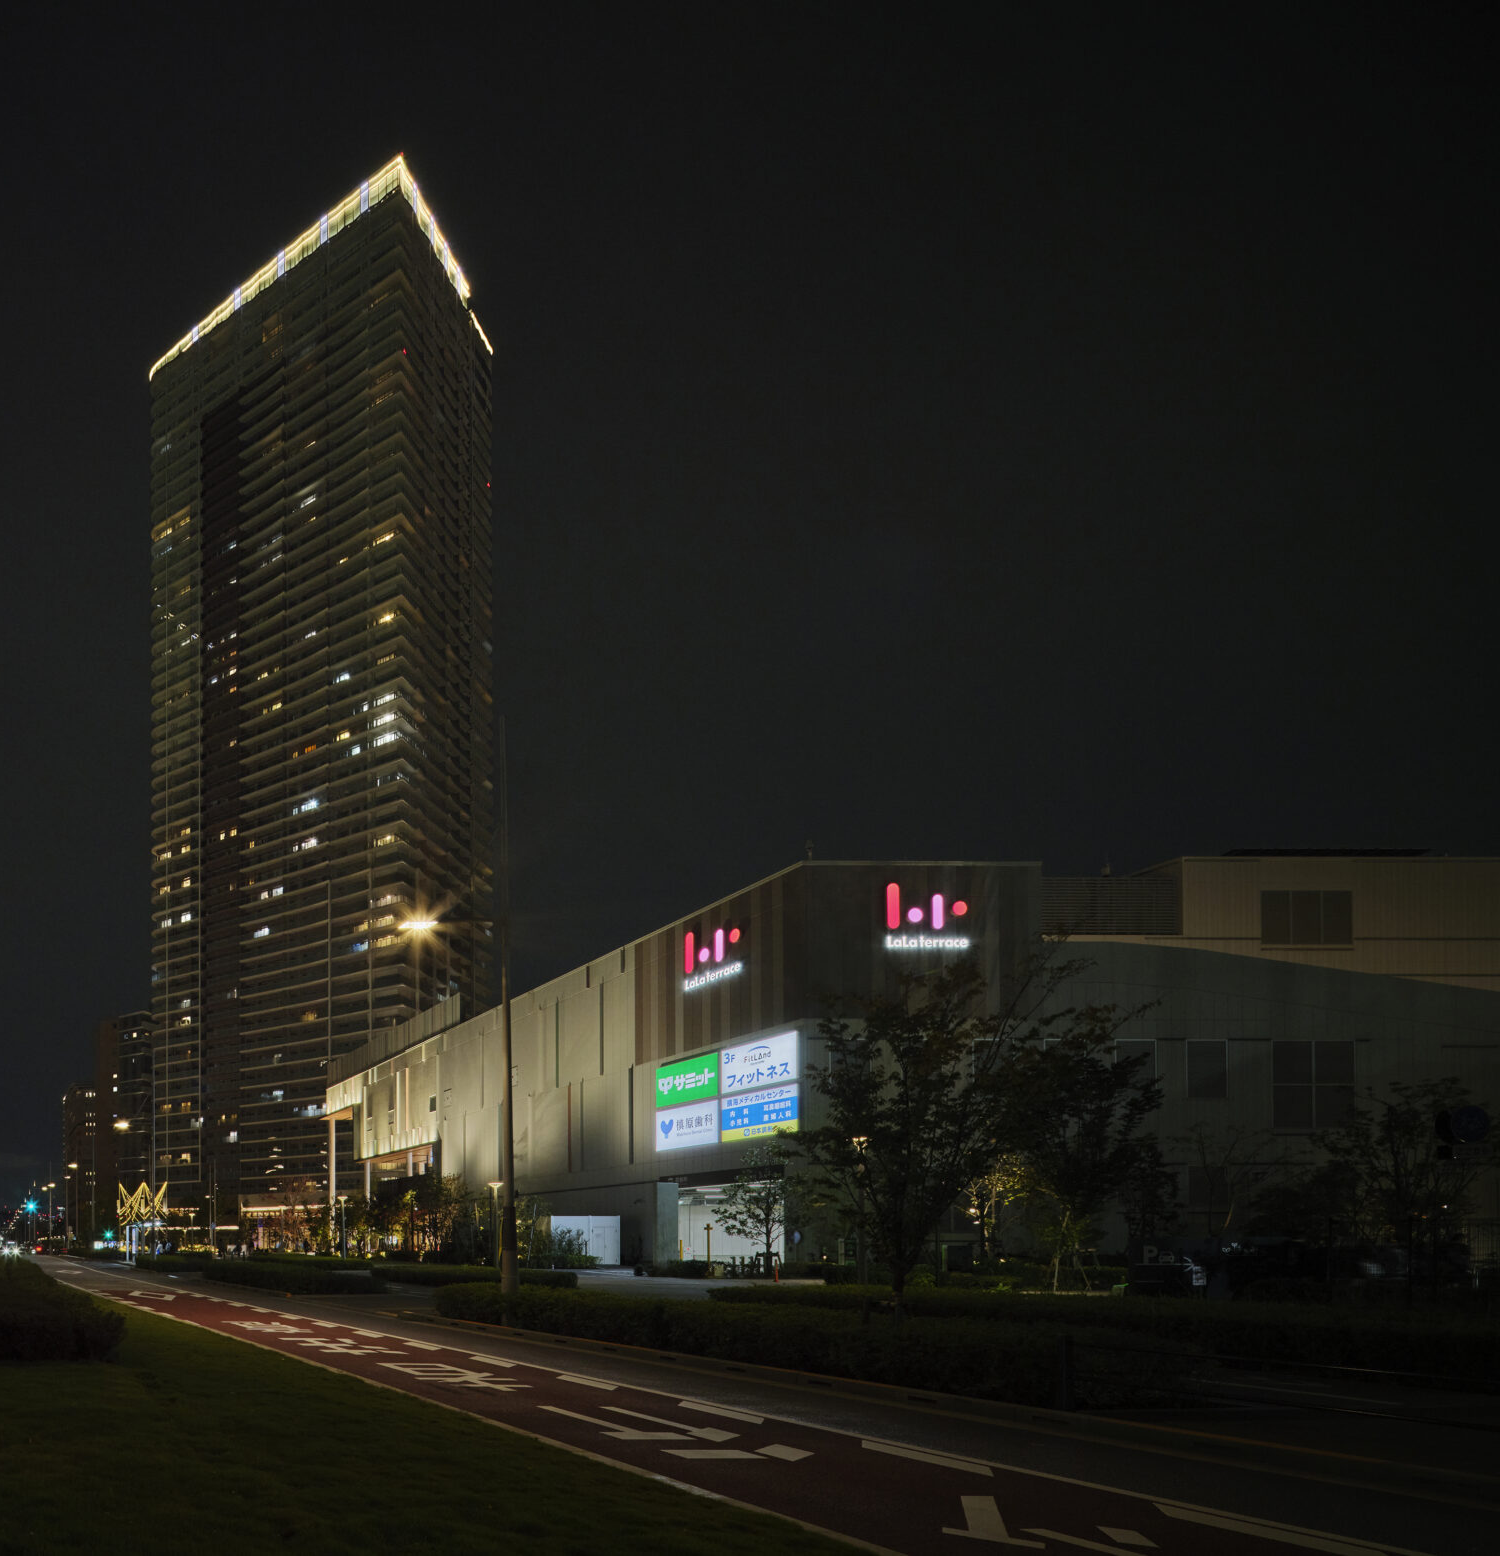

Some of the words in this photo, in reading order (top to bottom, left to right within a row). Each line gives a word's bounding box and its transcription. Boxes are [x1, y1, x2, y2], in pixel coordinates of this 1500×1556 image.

[724, 1052, 735, 1064] 3F
[674, 1068, 715, 1091] サミット
[727, 1062, 790, 1087] フィットネス
